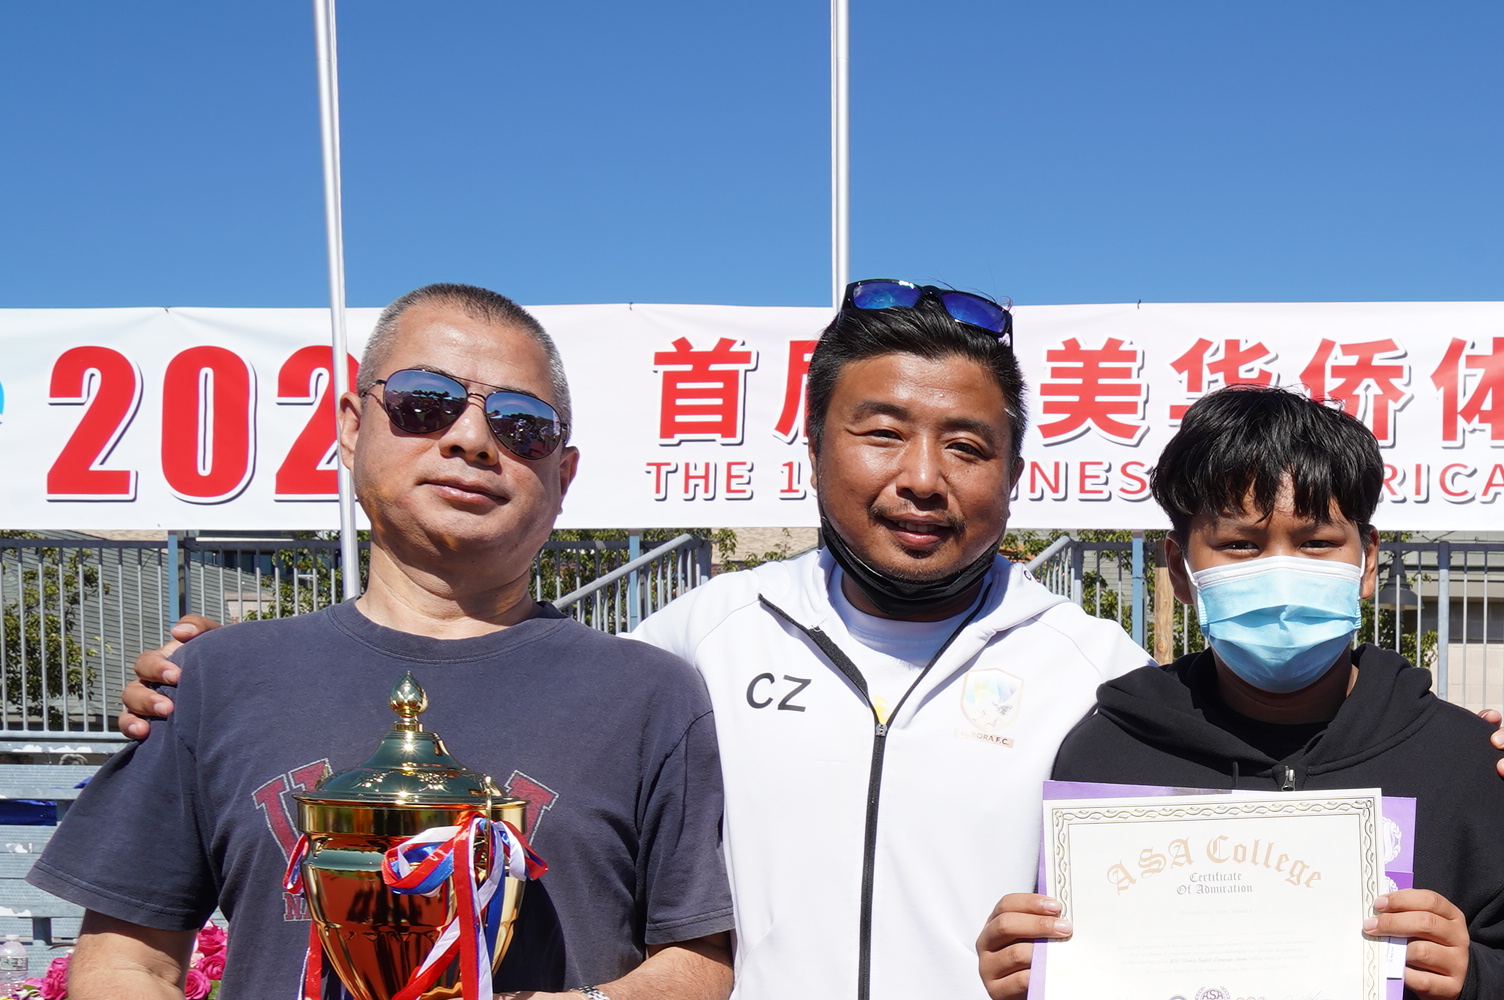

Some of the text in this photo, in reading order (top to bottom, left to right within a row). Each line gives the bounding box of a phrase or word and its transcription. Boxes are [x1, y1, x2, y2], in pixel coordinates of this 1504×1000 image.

[47, 345, 358, 502] 202
[645, 461, 754, 501] THE
[745, 671, 813, 714] CZ
[1106, 834, 1323, 896] ASA College
[1189, 871, 1243, 883] Certificate
[1176, 882, 1254, 896] Of Admiration
